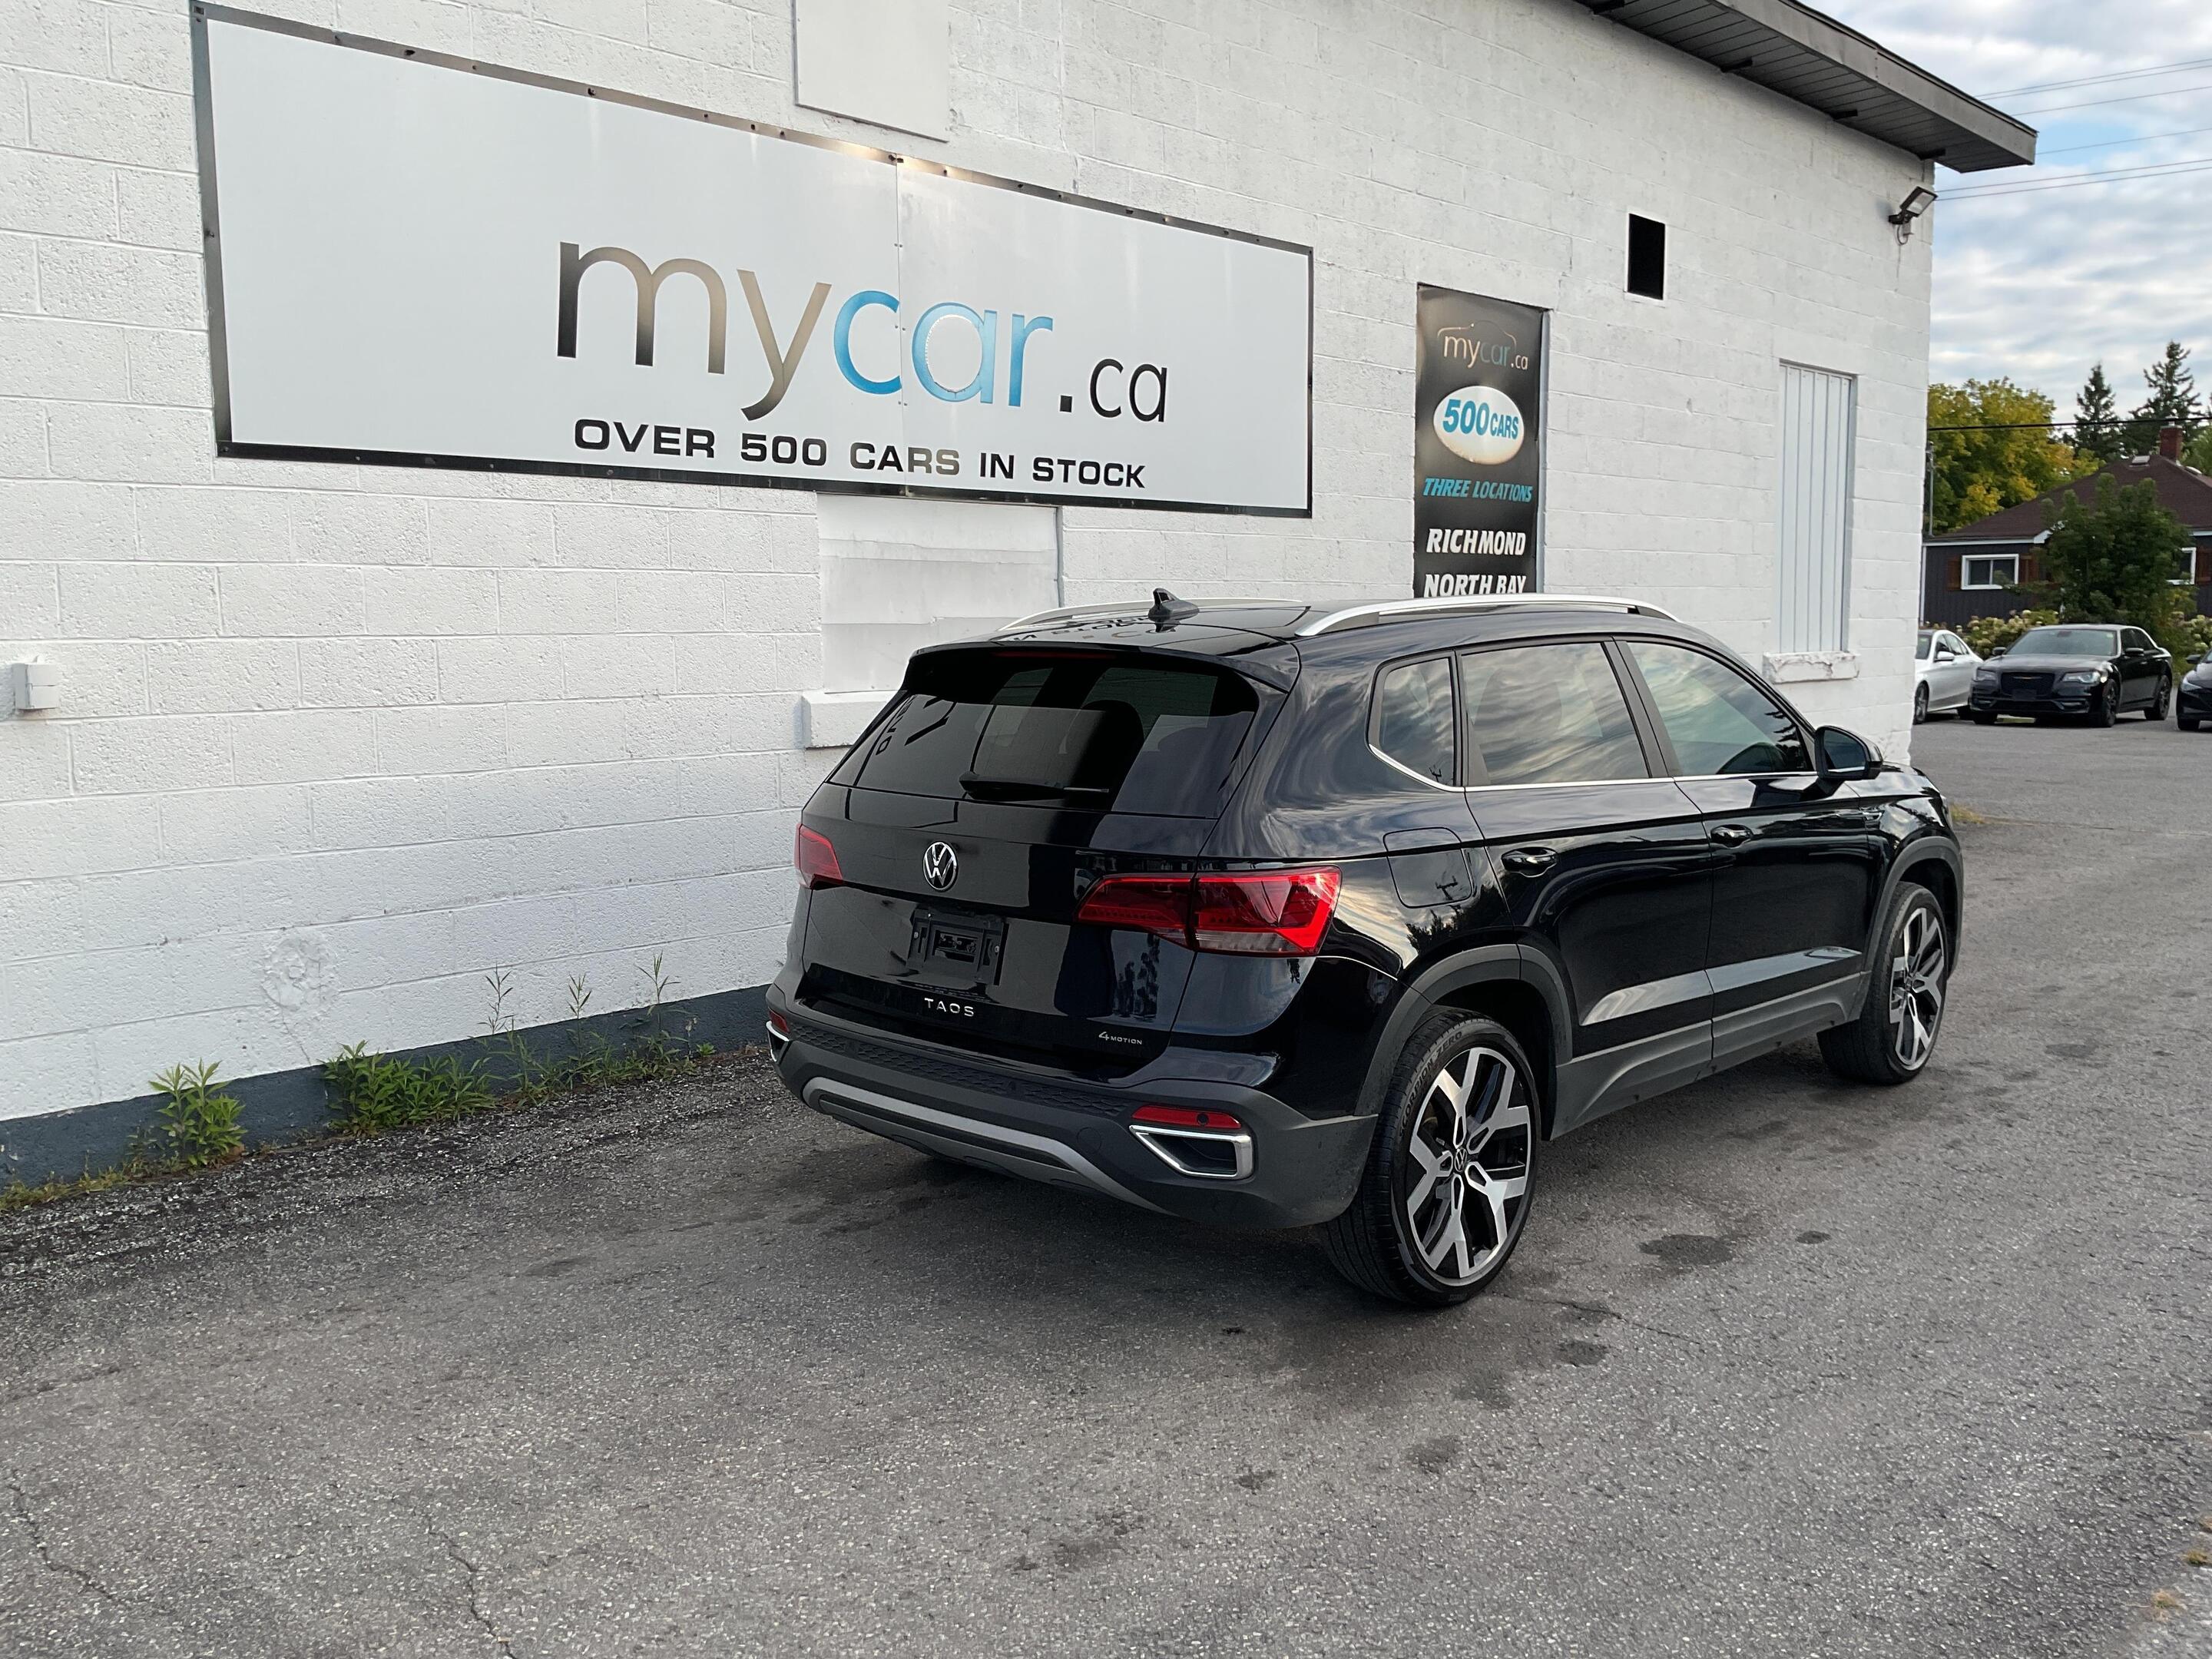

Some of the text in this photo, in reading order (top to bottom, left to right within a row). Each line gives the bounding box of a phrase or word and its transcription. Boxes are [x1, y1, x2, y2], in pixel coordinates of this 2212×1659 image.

[557, 241, 1168, 423] mycar.ca
[1444, 335, 1528, 370] mycar.ca
[1442, 399, 1519, 440] 500 CARS
[575, 419, 1146, 488] OVER 500 CARS IN STOCK
[1422, 478, 1534, 503] THREE LOCATIONS
[1426, 528, 1527, 555] RICHMOND
[1423, 573, 1527, 598] NORTH BAY
[924, 997, 975, 1018] TAOS
[1098, 1031, 1142, 1045] 4MOTION
